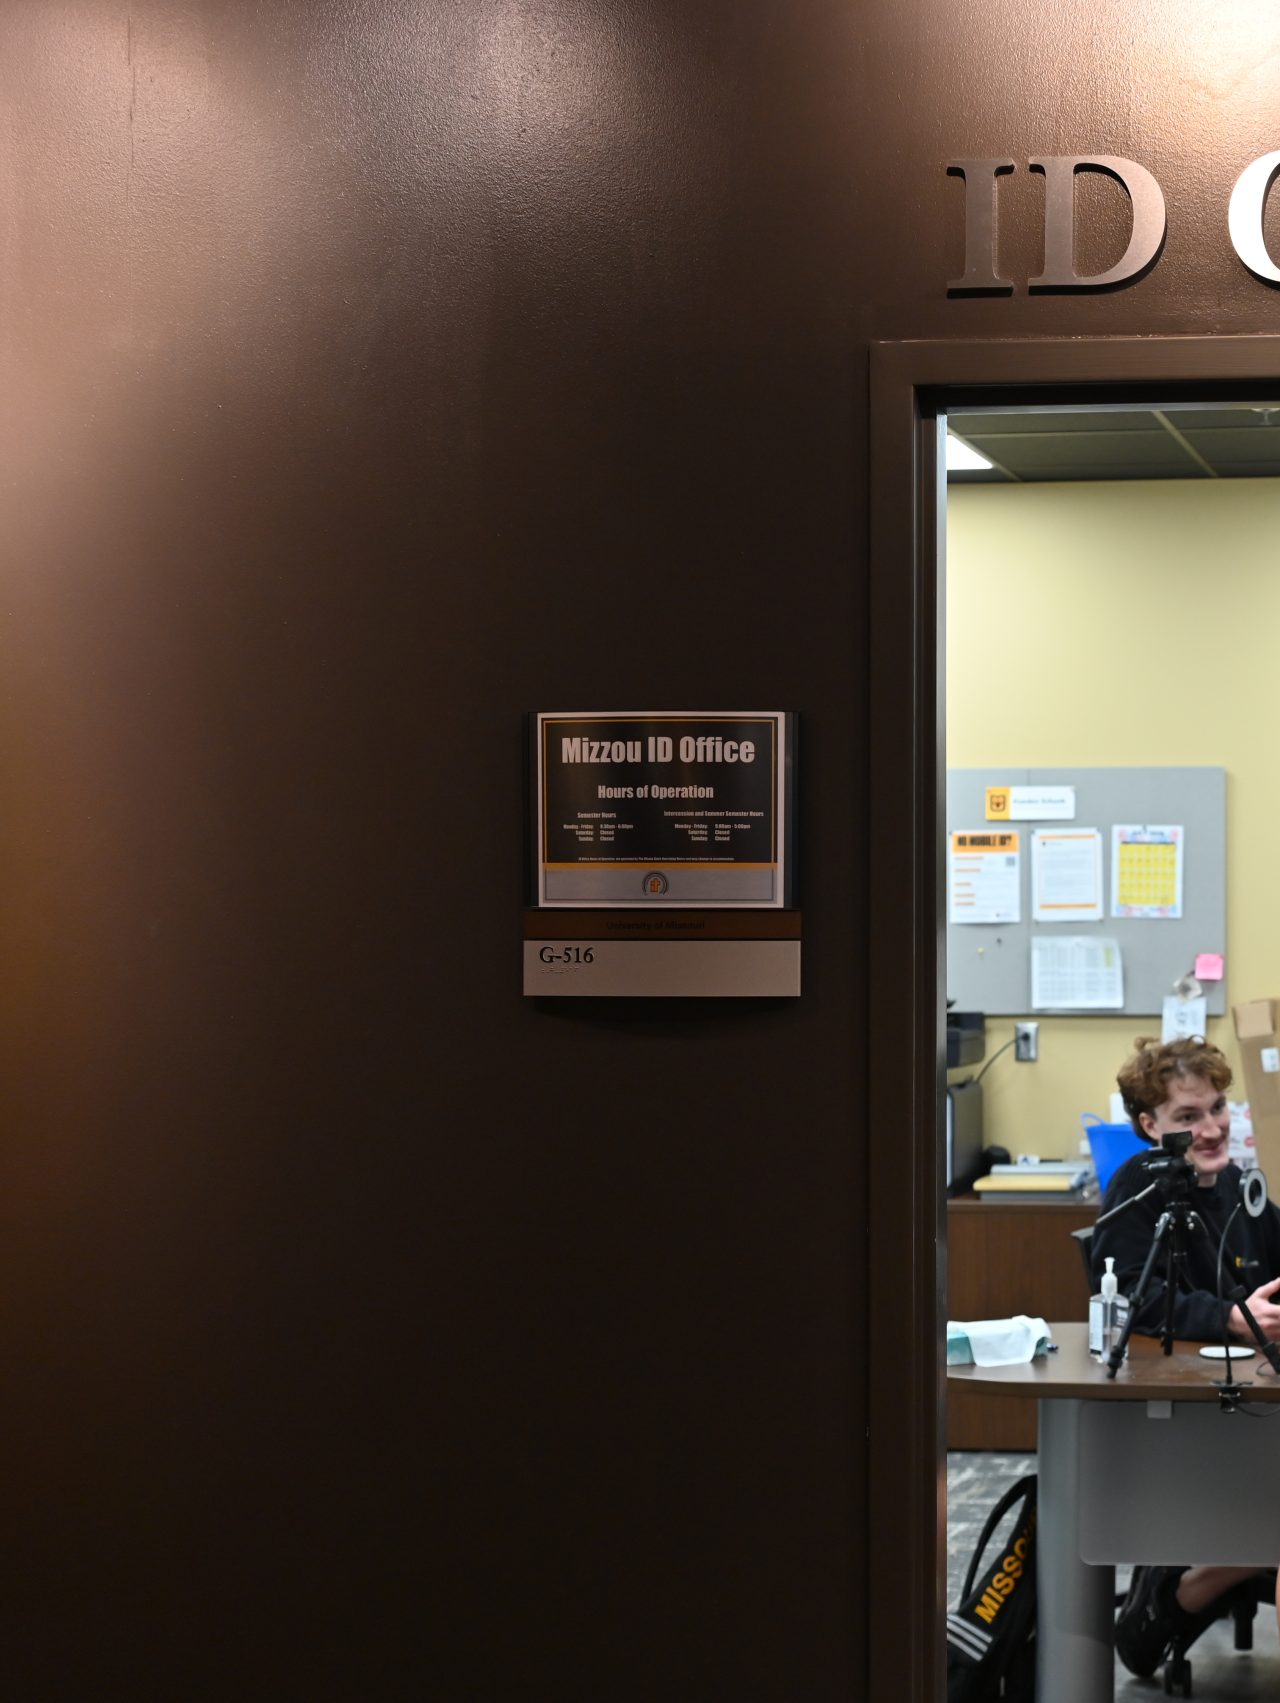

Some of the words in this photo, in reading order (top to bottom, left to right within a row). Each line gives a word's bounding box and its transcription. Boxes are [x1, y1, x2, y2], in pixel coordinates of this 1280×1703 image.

[946, 155, 1167, 298] ID
[561, 737, 642, 764] Mizzou
[648, 736, 673, 763] ID
[679, 736, 755, 763] Office
[597, 784, 634, 798] Hours
[636, 784, 649, 798] of
[651, 784, 714, 799] Operation
[539, 946, 594, 964] G-516
